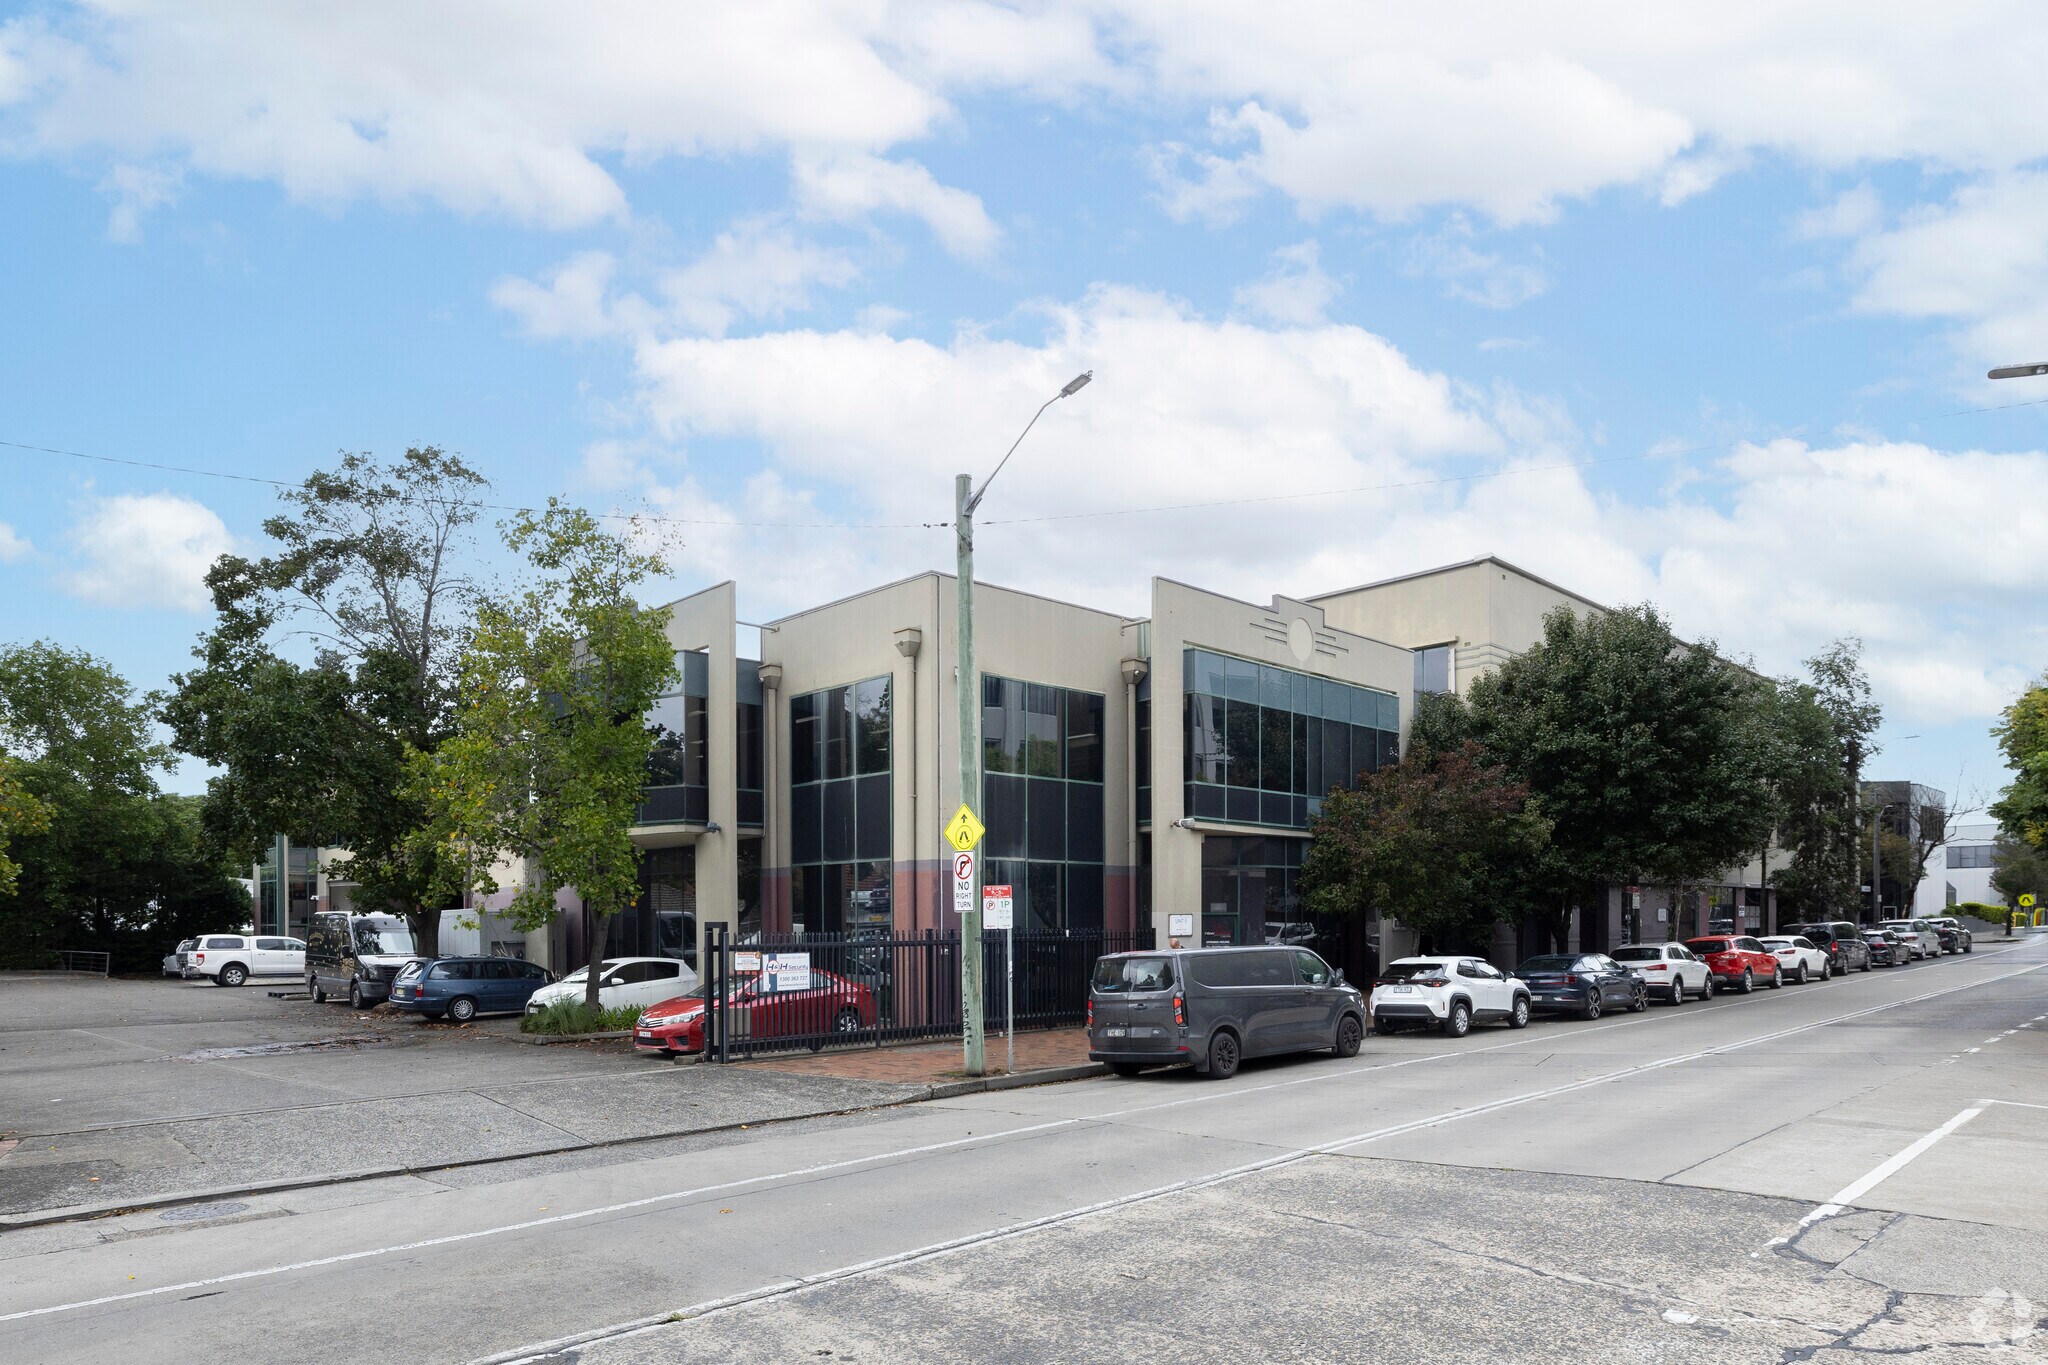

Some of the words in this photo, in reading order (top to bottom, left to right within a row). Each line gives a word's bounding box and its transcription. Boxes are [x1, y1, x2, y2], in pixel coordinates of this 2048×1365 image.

[958, 881, 970, 891] NO
[956, 892, 972, 900] RIGHT
[1001, 900, 1010, 908] 1P
